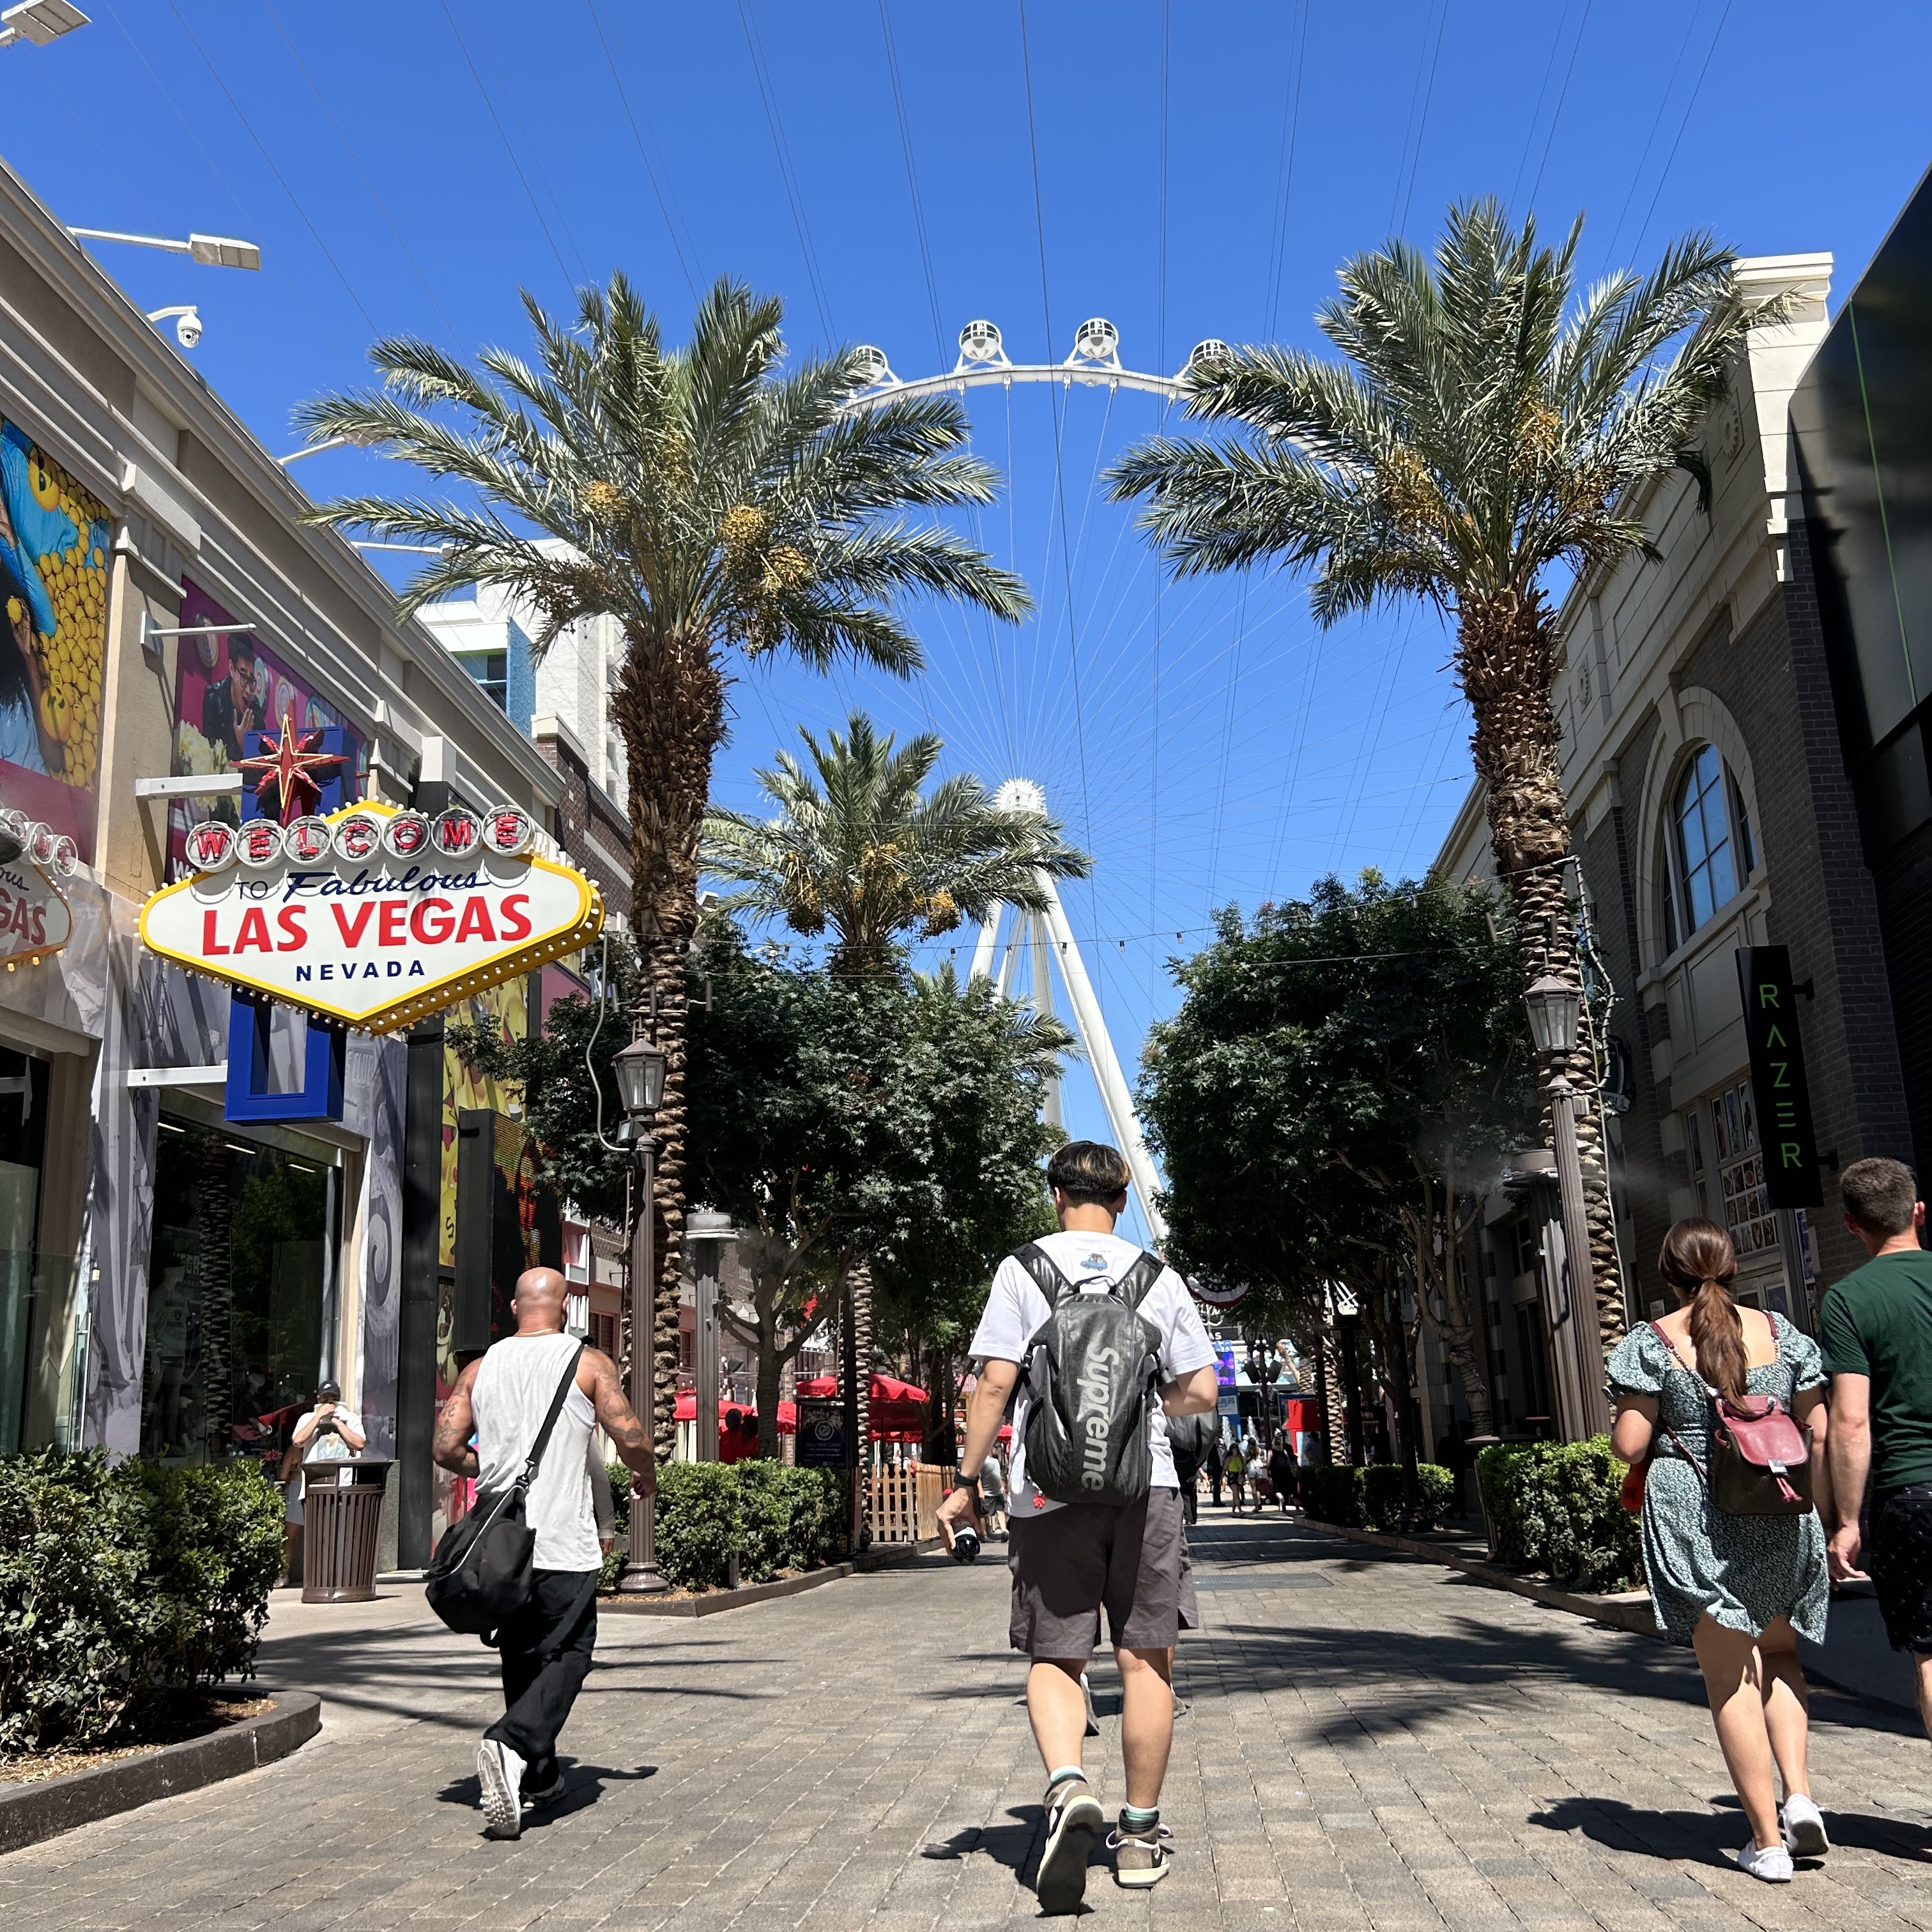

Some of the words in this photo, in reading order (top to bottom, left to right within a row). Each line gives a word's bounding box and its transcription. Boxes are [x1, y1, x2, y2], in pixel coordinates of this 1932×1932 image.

[195, 815, 518, 862] WELCOME
[0, 866, 29, 891] ous
[234, 880, 268, 900] TO
[283, 866, 491, 903] Fabulous
[0, 887, 46, 945] GAS
[203, 905, 308, 956] LAS
[330, 894, 532, 948] VEGAS
[296, 960, 425, 982] NEVADA
[1759, 984, 1802, 1168] RAZER
[1076, 1342, 1120, 1491] Supreme
